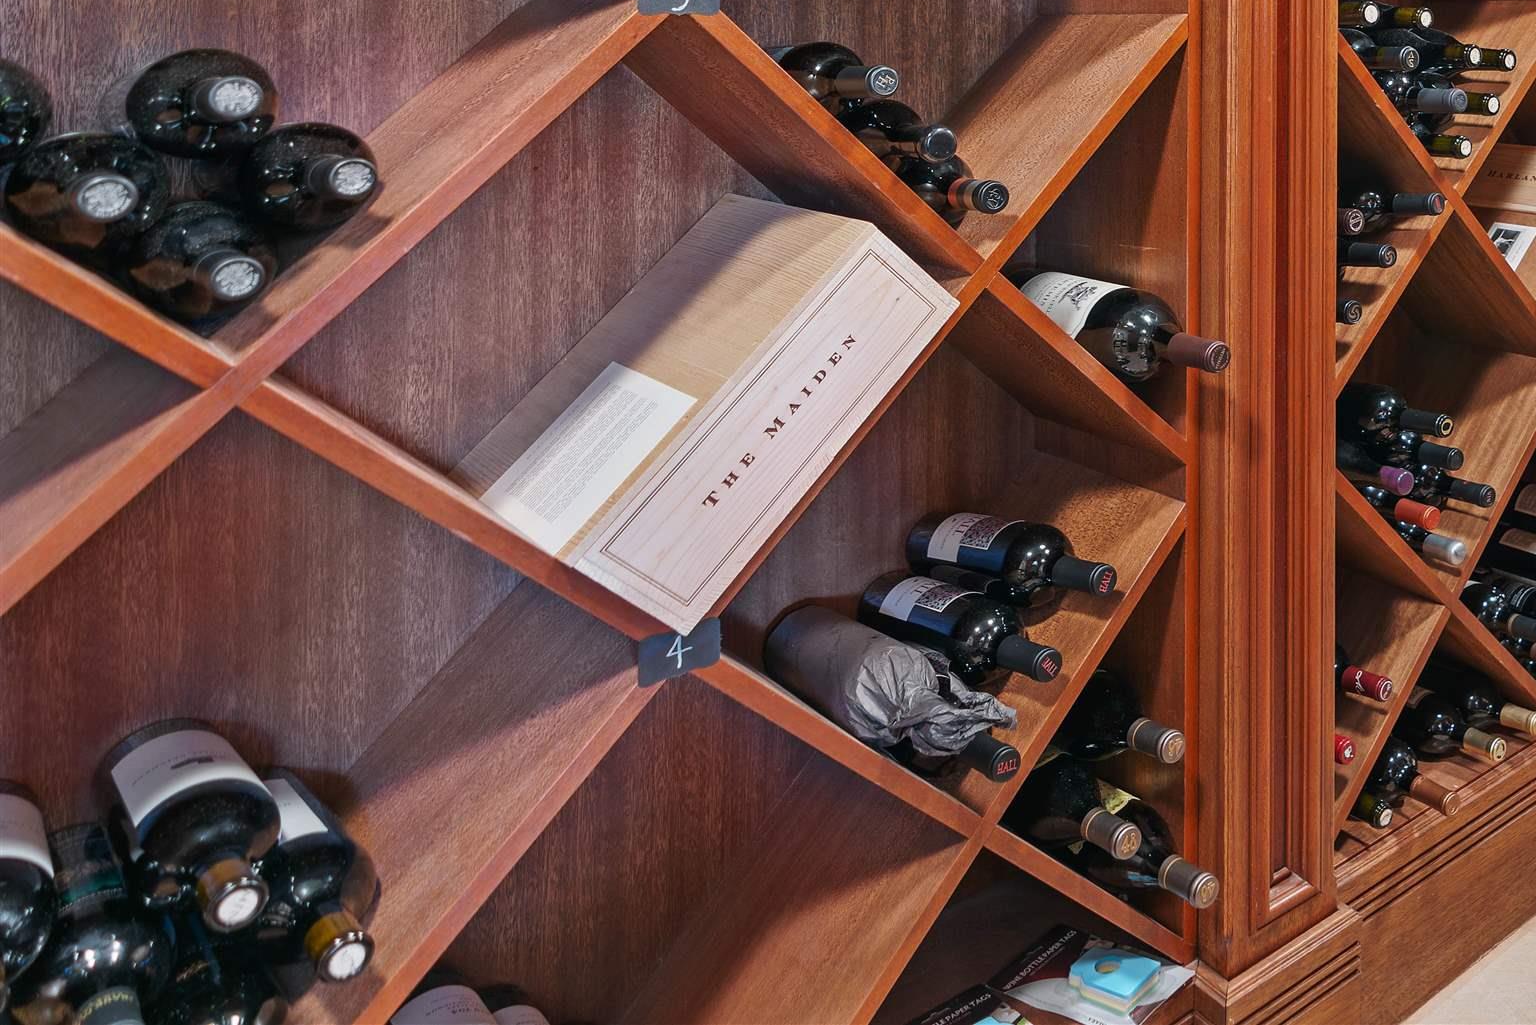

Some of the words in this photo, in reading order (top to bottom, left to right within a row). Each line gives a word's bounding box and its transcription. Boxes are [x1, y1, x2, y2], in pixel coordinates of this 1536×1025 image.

[702, 452, 756, 508] THE
[763, 334, 857, 439] MAIDEN
[1099, 570, 1114, 593] HALL
[665, 634, 693, 669] 4
[996, 758, 1018, 776] HALL
[1019, 954, 1046, 977] BOTTLE
[1042, 940, 1062, 961] PAPER
[1058, 930, 1077, 947] TAGS
[947, 1001, 972, 1022] PAPER
[970, 993, 991, 1009] TAGS
